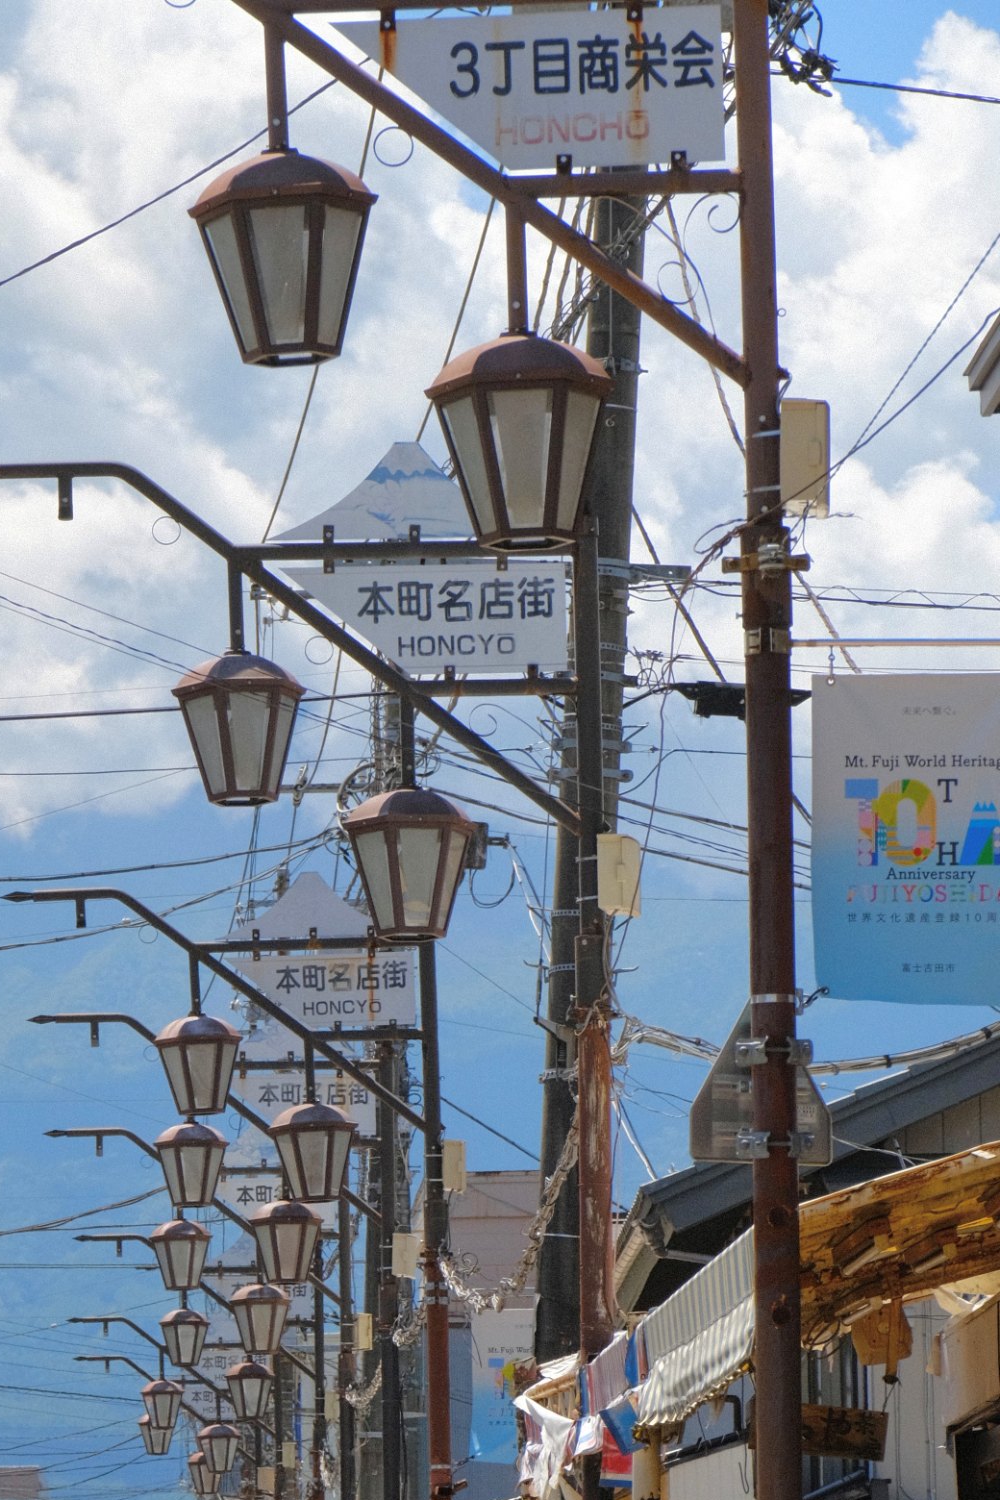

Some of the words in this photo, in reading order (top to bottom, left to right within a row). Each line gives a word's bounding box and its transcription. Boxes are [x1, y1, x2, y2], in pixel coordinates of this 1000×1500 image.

[449, 30, 715, 98] 3丁目商栄会
[357, 575, 555, 624] 本町名店街
[845, 756, 869, 768] Mt.
[872, 755, 900, 771] Fuji
[905, 755, 946, 768] World
[886, 867, 976, 884] Anniversary
[276, 960, 408, 994] 本町名店街
